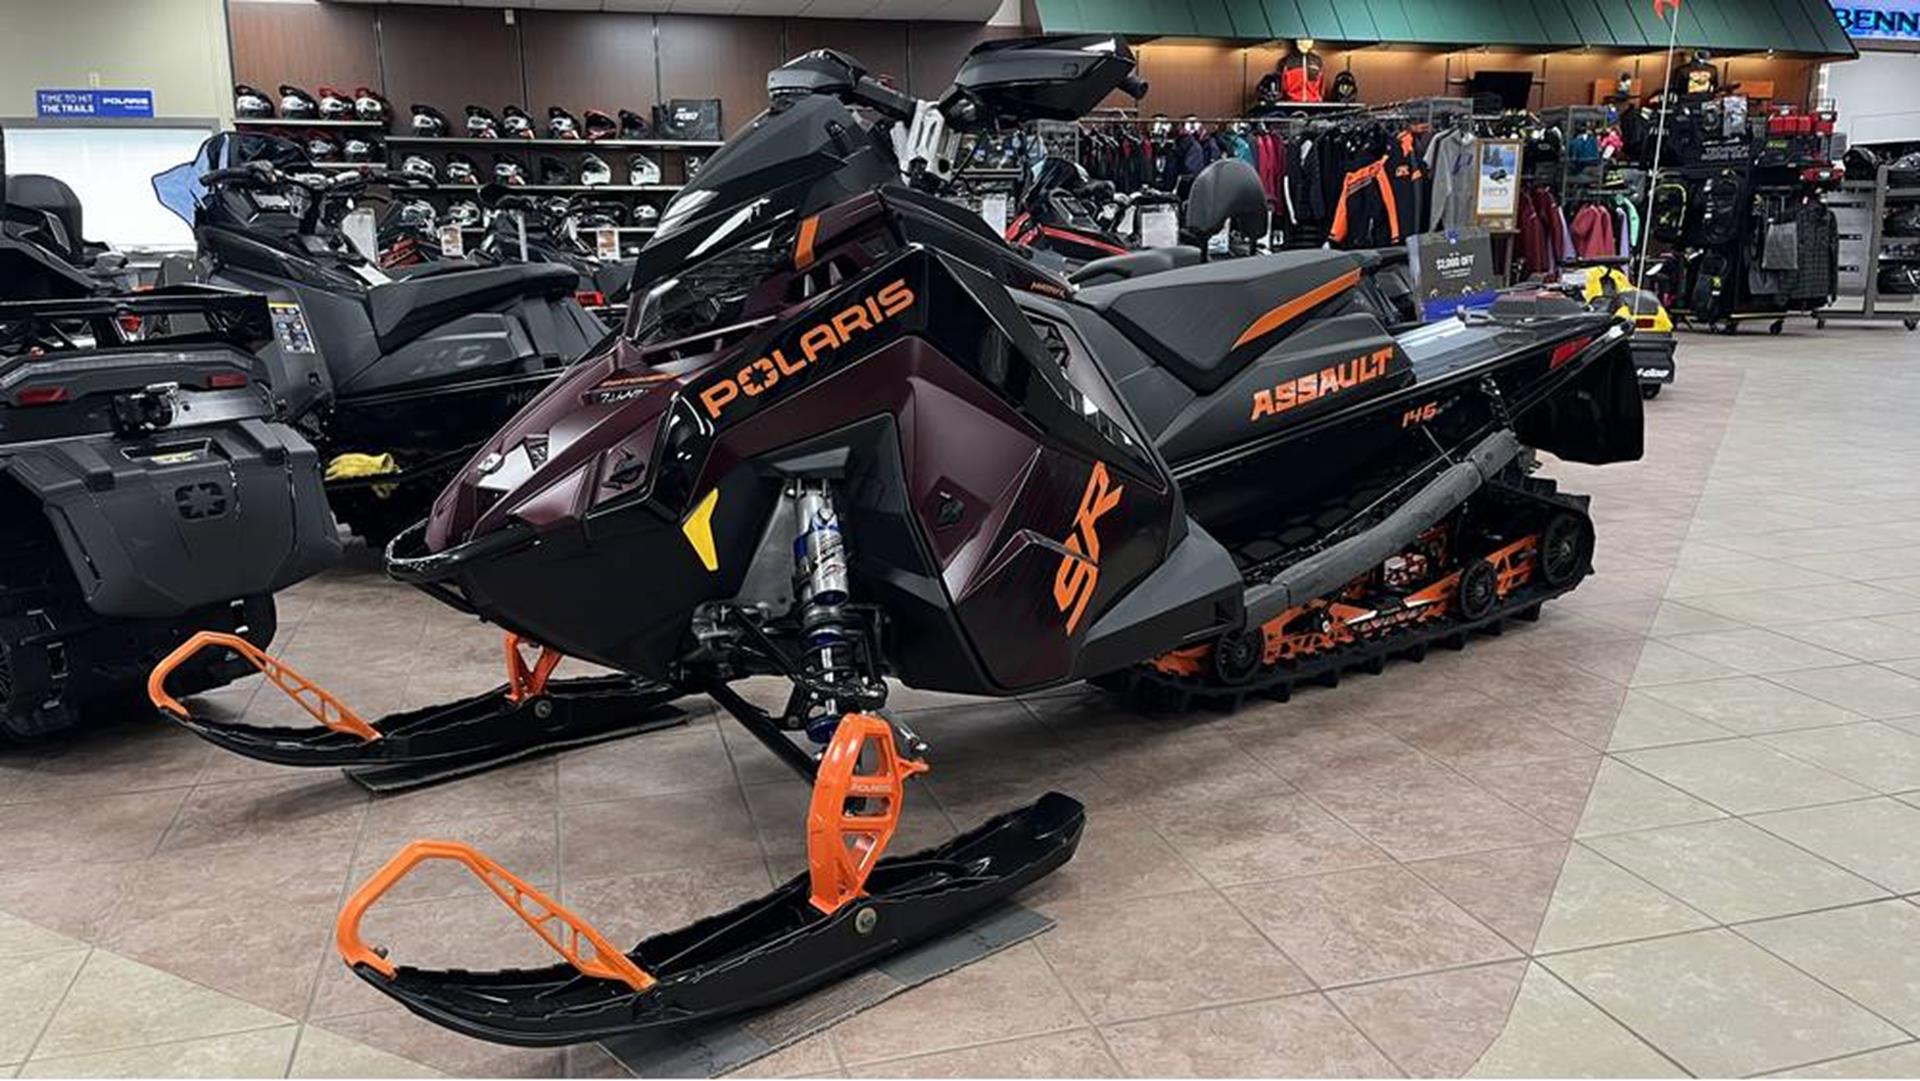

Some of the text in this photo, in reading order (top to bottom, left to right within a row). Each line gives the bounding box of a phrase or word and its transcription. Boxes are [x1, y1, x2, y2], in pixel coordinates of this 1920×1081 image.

[41, 94, 93, 104] TIME TO HIT
[103, 97, 149, 105] POLARIS
[42, 104, 95, 113] THE TRAILS
[700, 278, 915, 419] POLARIS
[1251, 347, 1393, 422] ASSAULT
